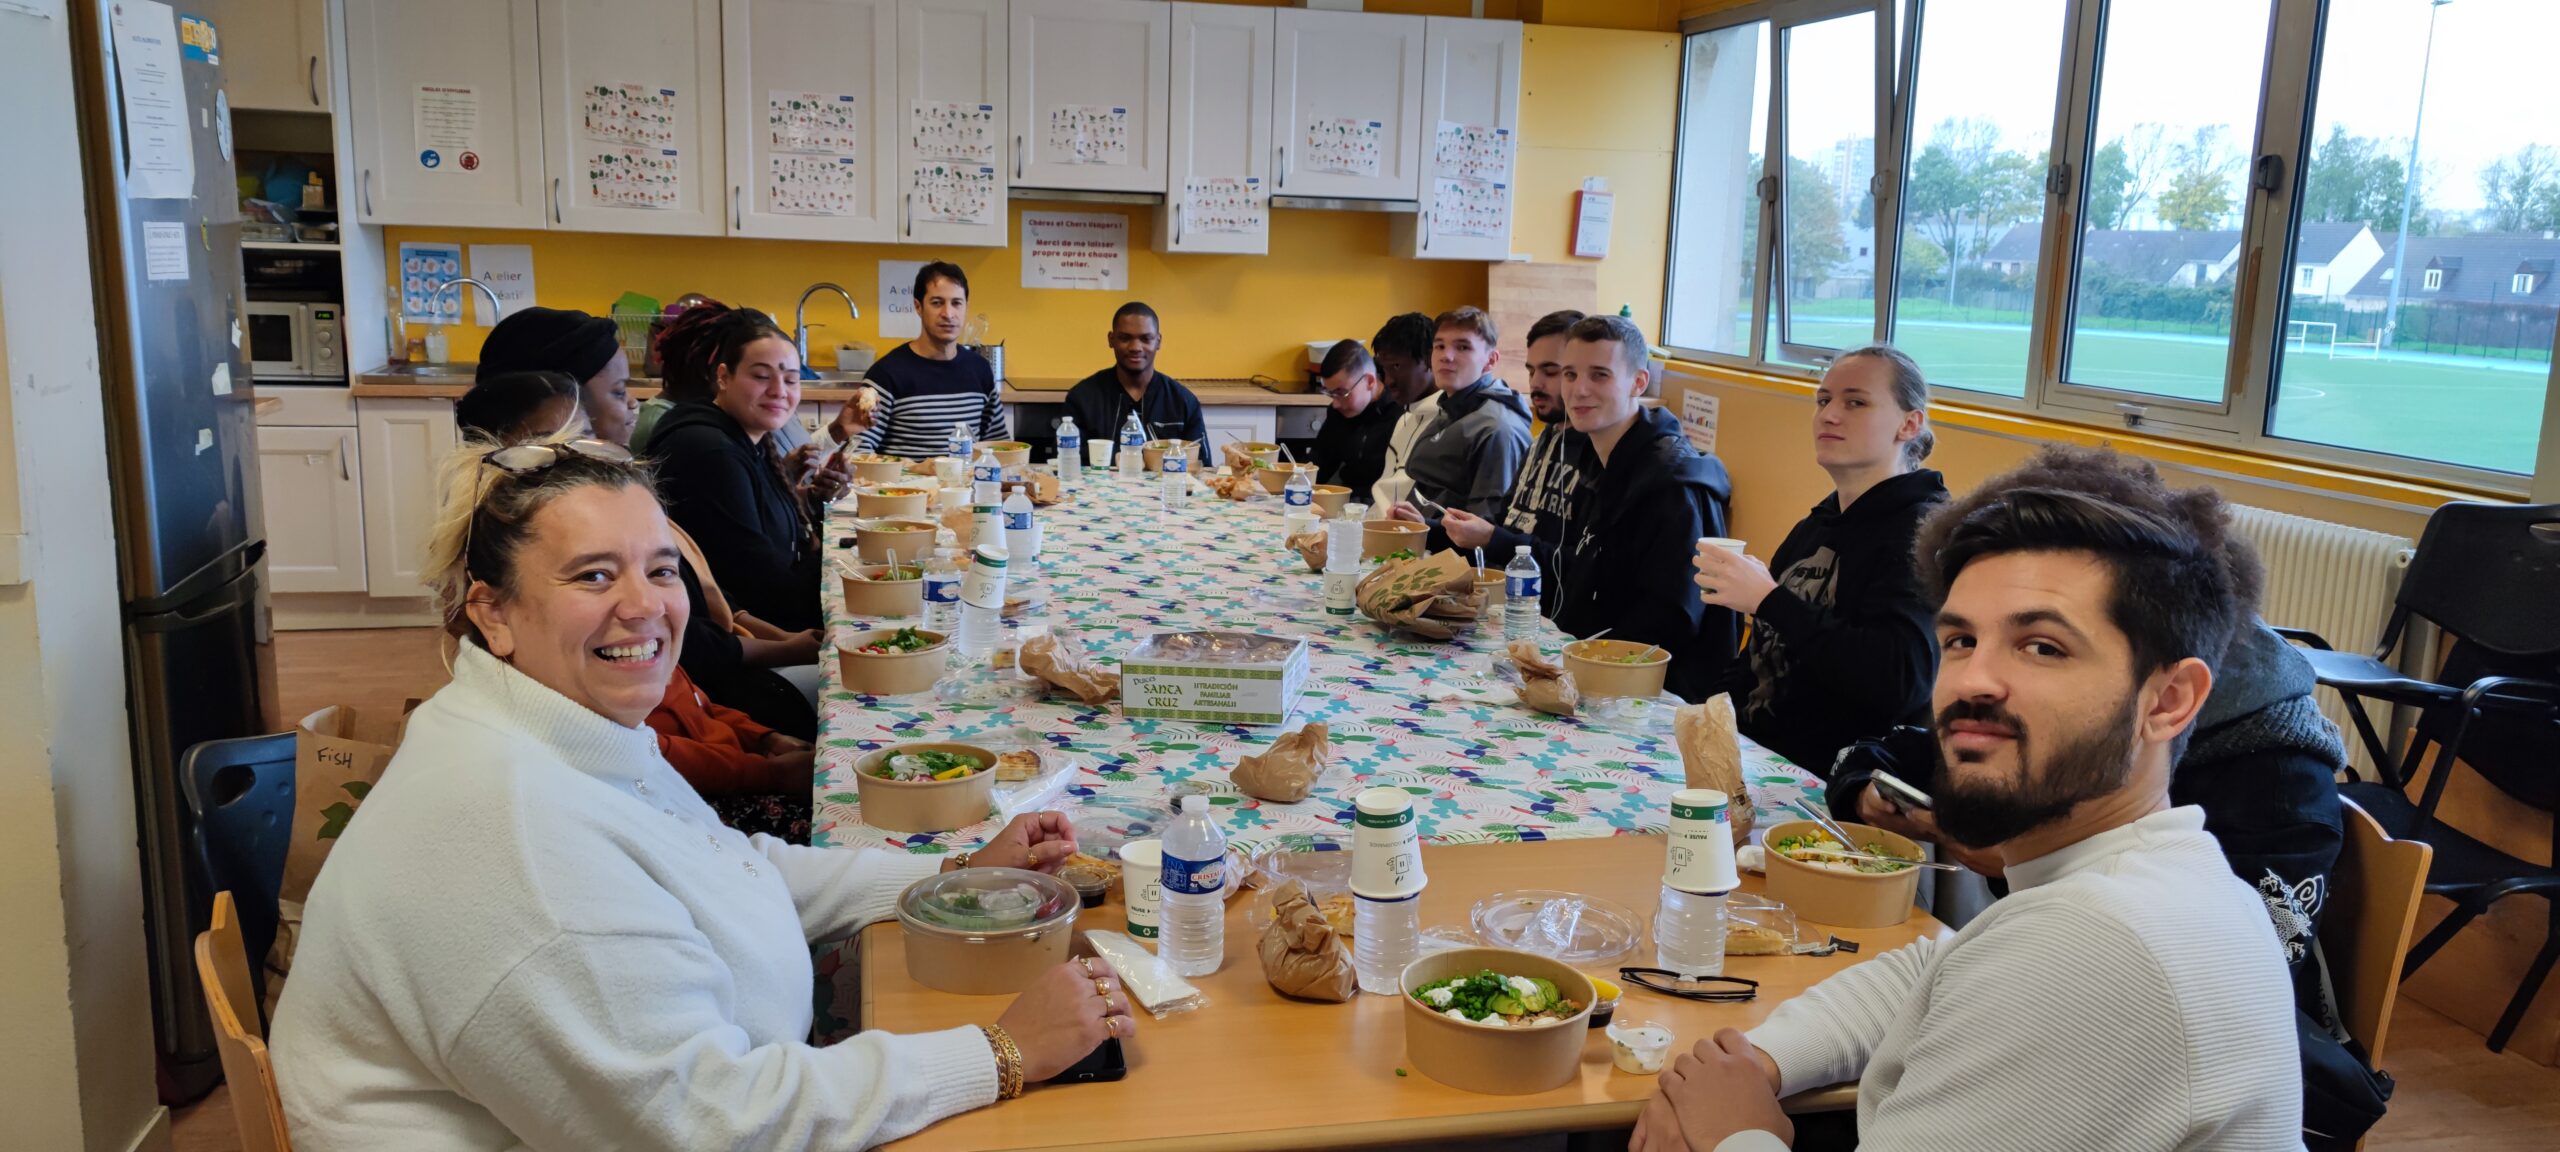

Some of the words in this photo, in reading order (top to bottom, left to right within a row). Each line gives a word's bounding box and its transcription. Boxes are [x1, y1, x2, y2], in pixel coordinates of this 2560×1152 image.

[1065, 220, 1087, 228] Chers
[1087, 240, 1115, 248] laisser
[1062, 250, 1086, 258] après
[1088, 251, 1118, 259] chaque
[889, 285, 914, 295] Aeli
[888, 303, 914, 313] Cuisi
[1143, 683, 1183, 695] SANTA
[1200, 691, 1232, 699] FAMILIAR
[1147, 697, 1179, 707] CRUZ
